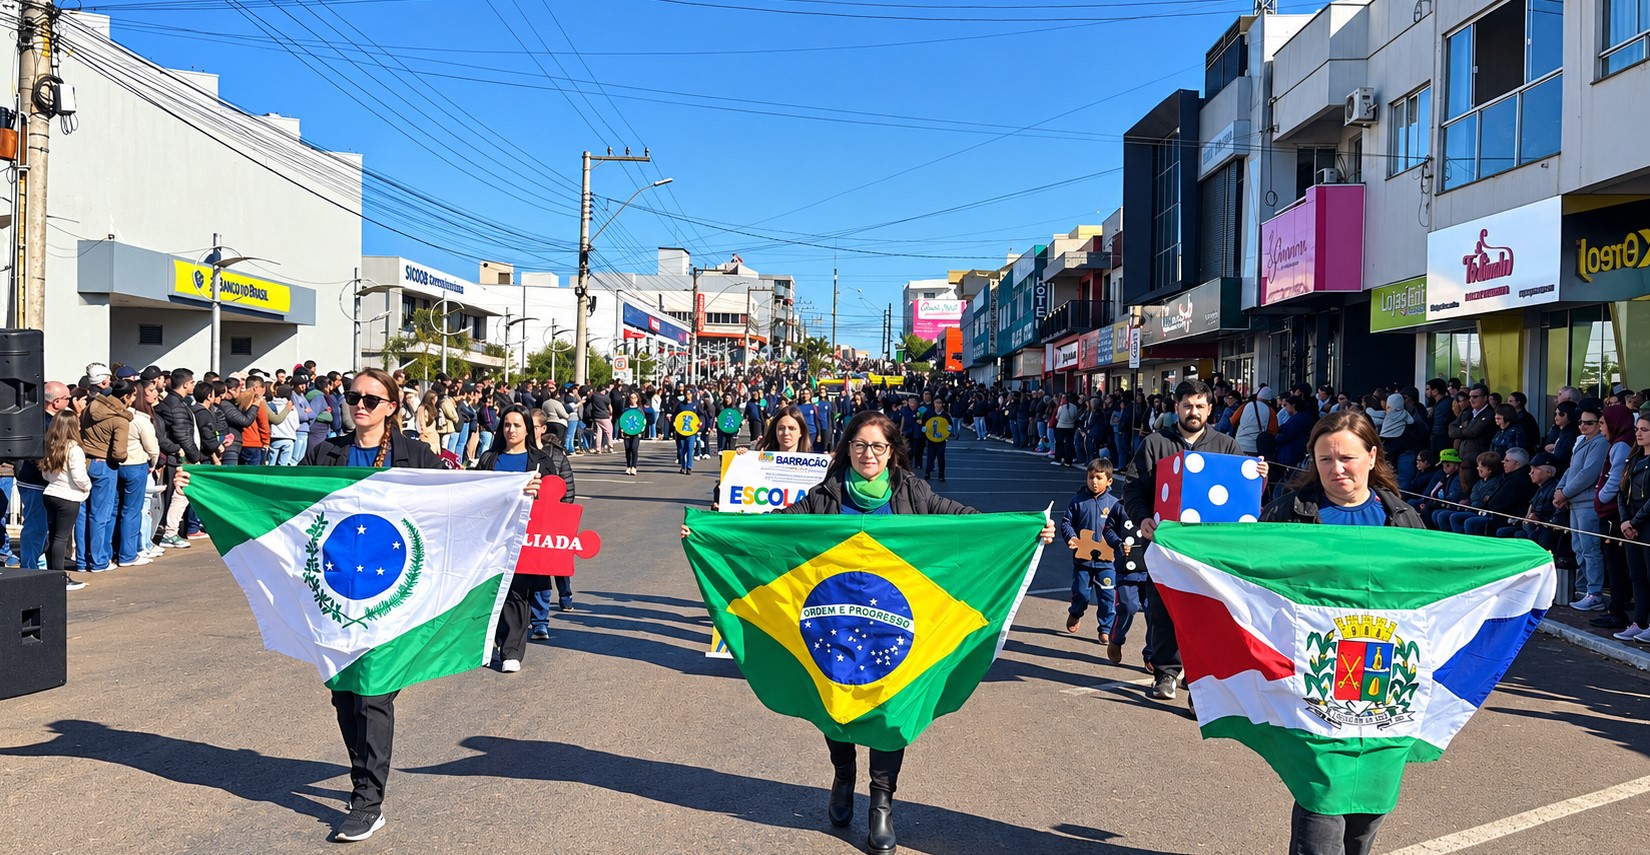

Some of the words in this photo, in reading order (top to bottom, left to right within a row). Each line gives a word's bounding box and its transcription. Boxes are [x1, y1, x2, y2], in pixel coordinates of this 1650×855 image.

[775, 455, 828, 468] BARRACÃO
[803, 606, 836, 618] ORDEM
[839, 606, 845, 614] E
